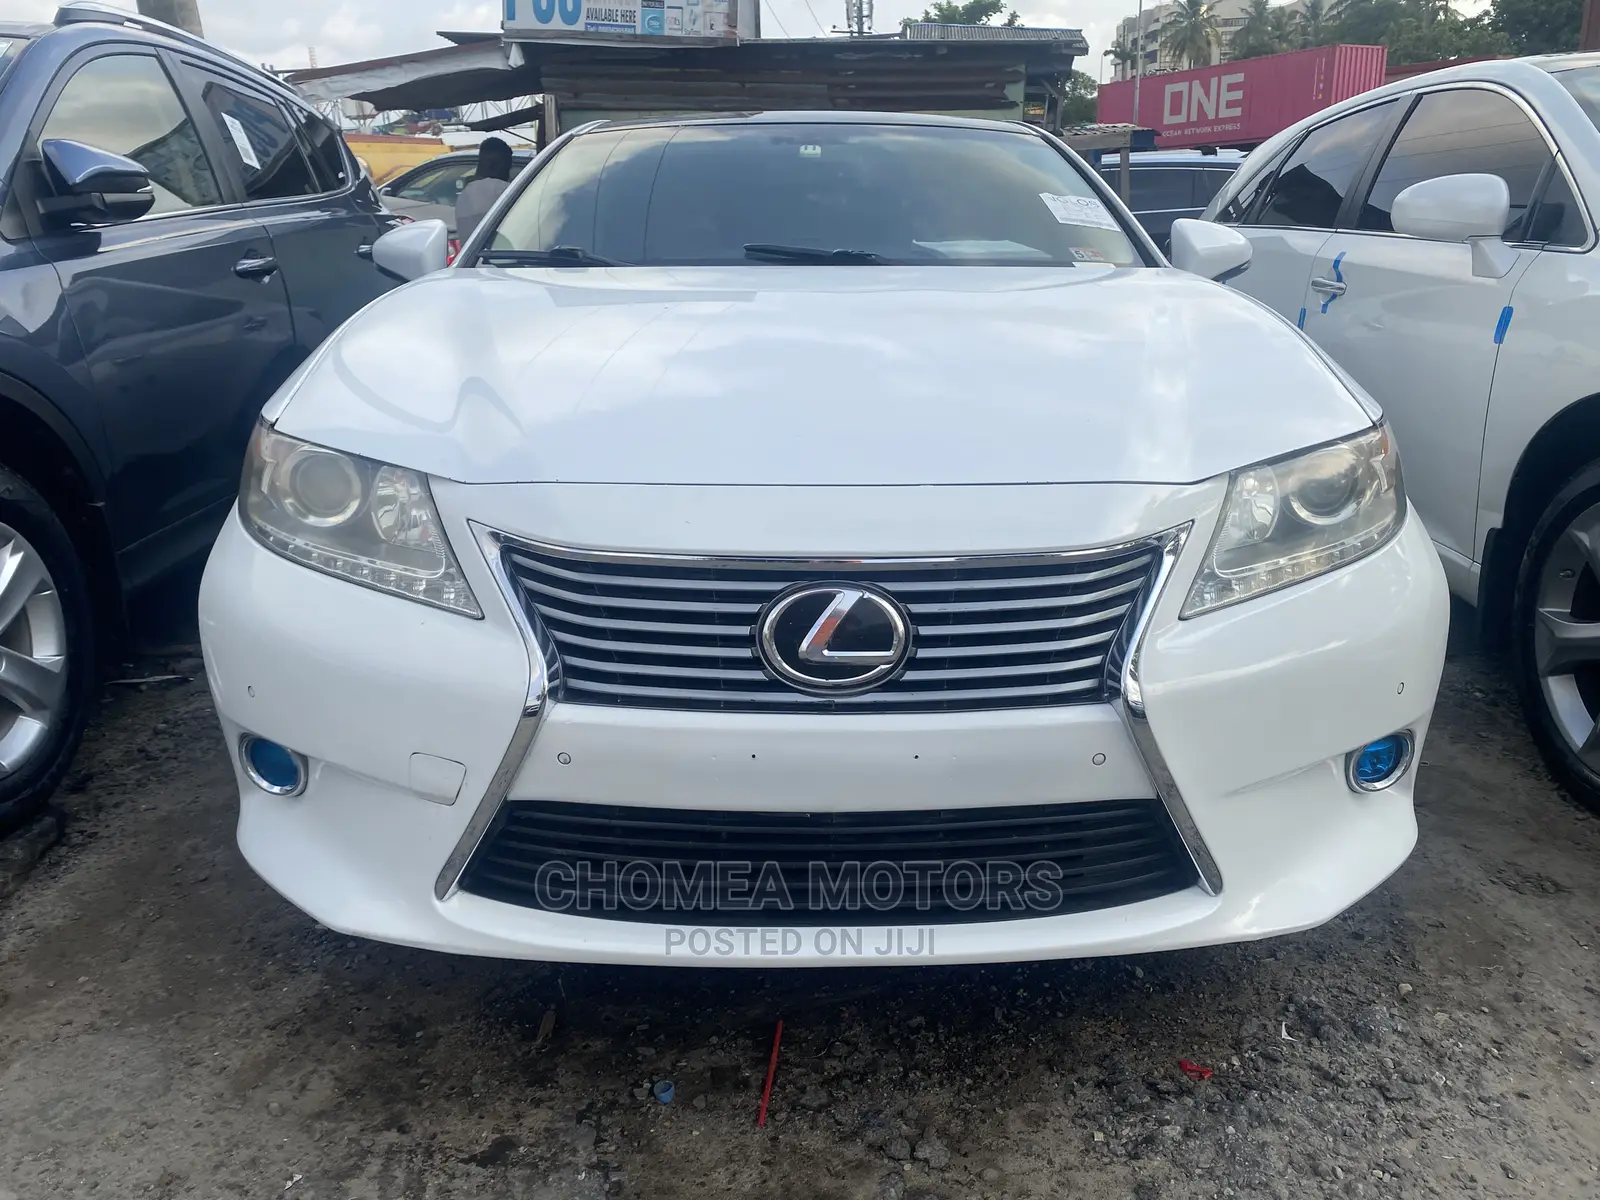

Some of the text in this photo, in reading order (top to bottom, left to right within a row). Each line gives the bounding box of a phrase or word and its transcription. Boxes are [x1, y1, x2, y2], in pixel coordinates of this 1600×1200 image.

[586, 7, 619, 22] AVAILABLE
[620, 9, 637, 23] HERE
[1163, 73, 1245, 125] ONE
[1162, 122, 1241, 137] OCEAN NETWORK EXPRESS
